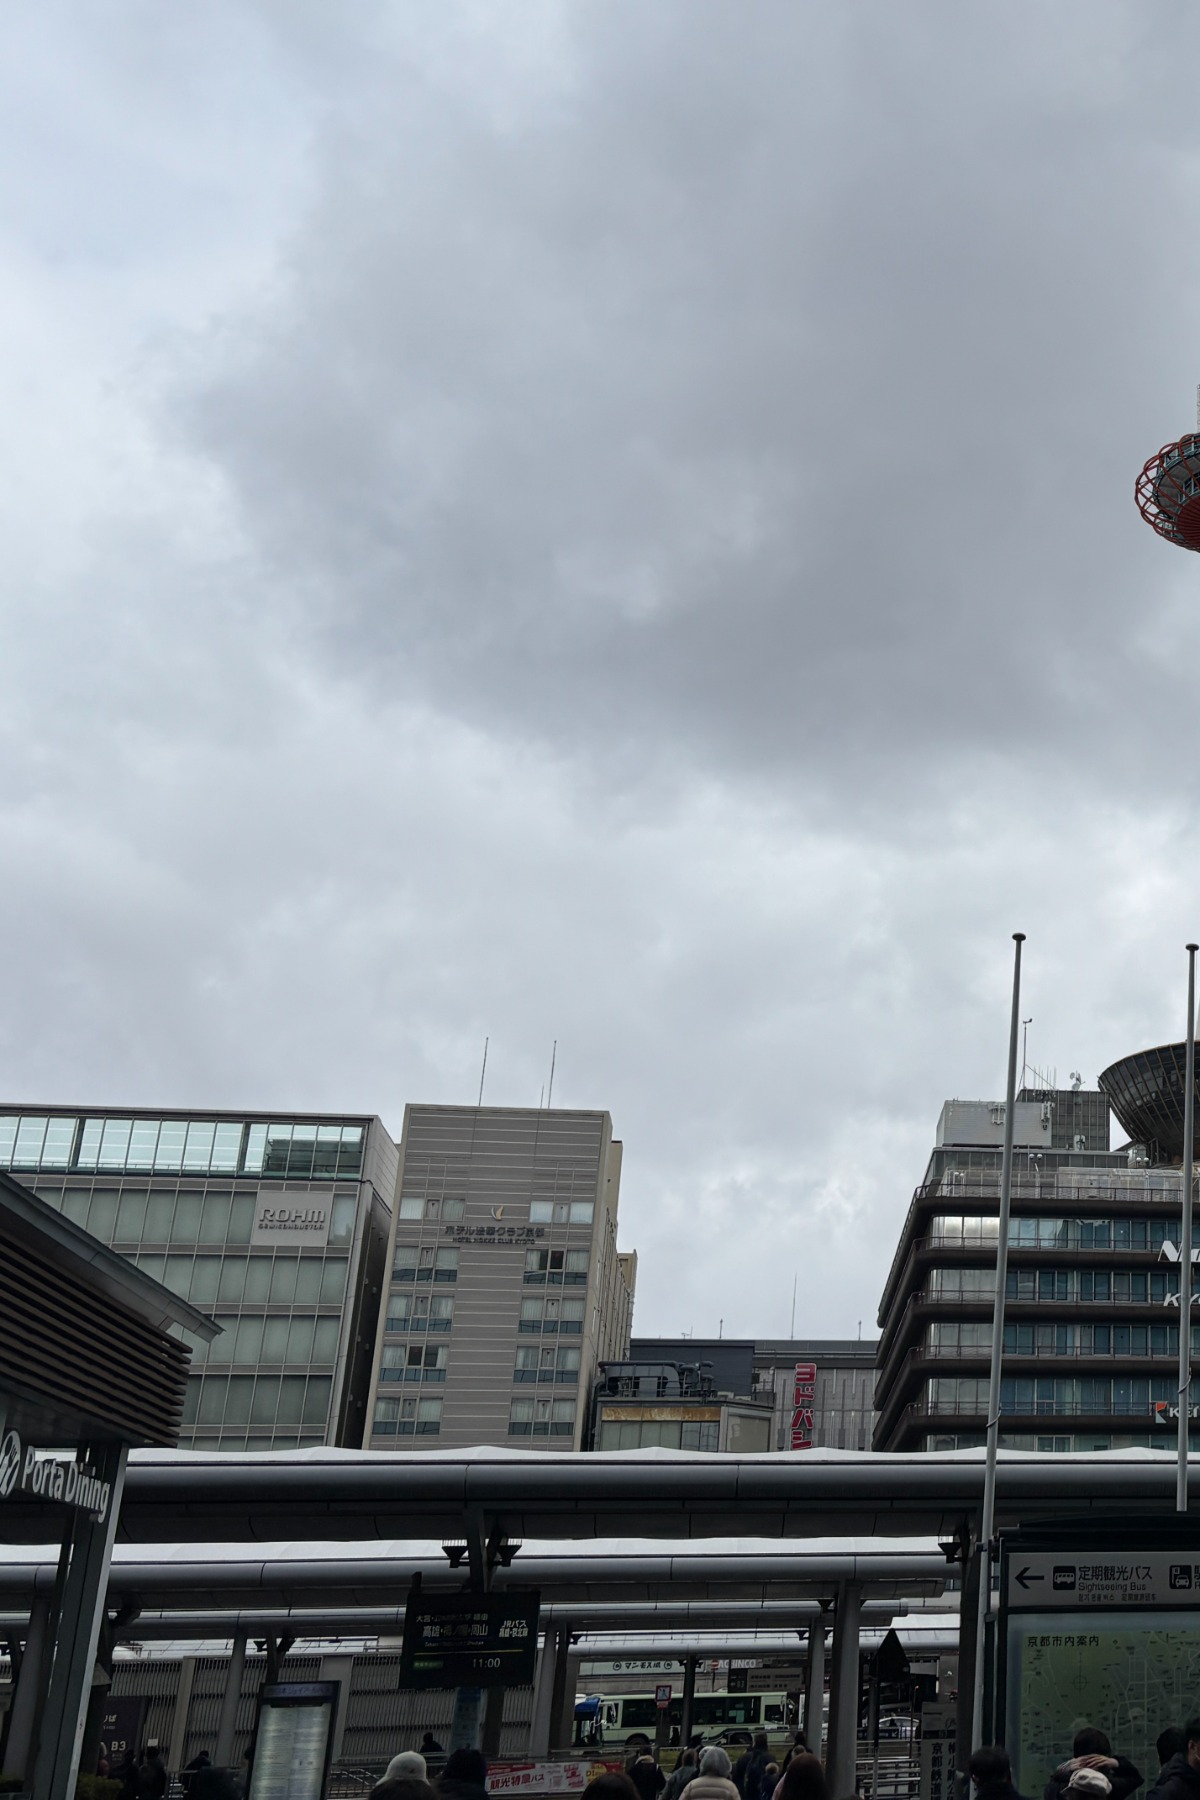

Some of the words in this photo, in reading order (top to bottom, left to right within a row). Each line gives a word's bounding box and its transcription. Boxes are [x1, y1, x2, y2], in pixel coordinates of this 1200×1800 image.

[259, 1208, 326, 1223] ROHM
[445, 1226, 545, 1238] ホテル法華クラブ京都
[791, 1362, 817, 1450] ヨドバシ
[21, 1445, 65, 1500] Porta
[65, 1461, 111, 1523] Dining
[1078, 1565, 1153, 1581] 定期観光バス
[1078, 1582, 1128, 1593] Sightseeing
[1130, 1582, 1147, 1591] Bus
[1027, 1635, 1099, 1648] 京都市内案内
[473, 1657, 501, 1668] 11:00
[717, 1659, 757, 1670] ACHINCO
[111, 1741, 127, 1752] B3
